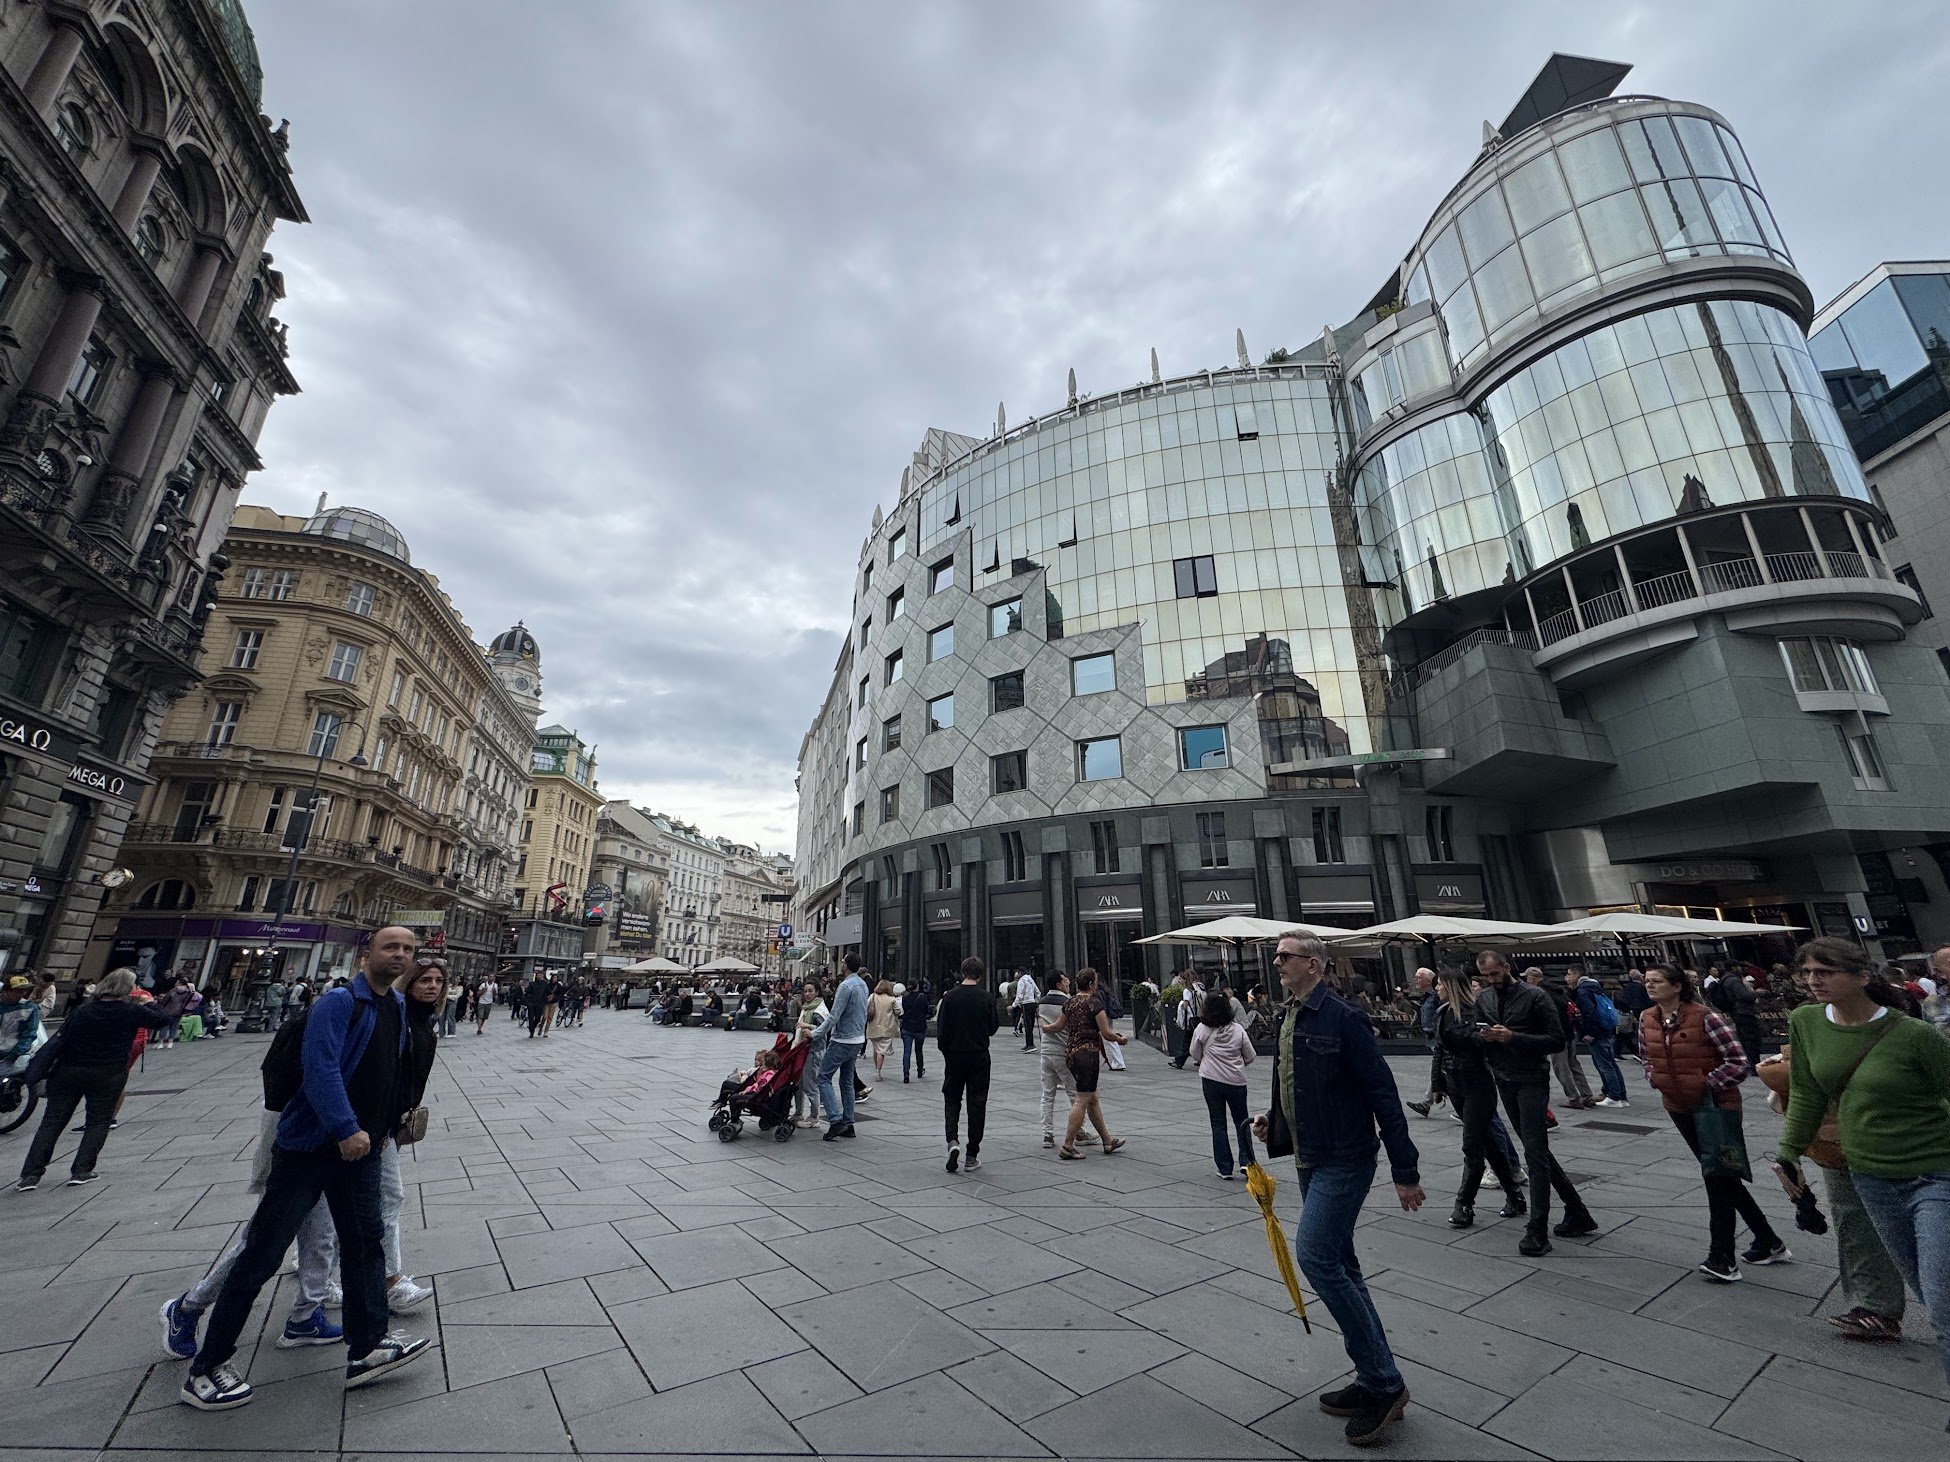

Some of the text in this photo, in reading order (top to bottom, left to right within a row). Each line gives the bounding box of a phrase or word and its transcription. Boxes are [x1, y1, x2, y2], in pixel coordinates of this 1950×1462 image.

[1660, 865, 1686, 877] DO
[1688, 865, 1697, 876] &
[1701, 864, 1724, 875] CO
[1206, 890, 1231, 901] ZARA
[1437, 885, 1462, 897] ZARA
[1098, 896, 1120, 906] ZARA
[1855, 917, 1868, 933] U
[781, 926, 791, 937] U
